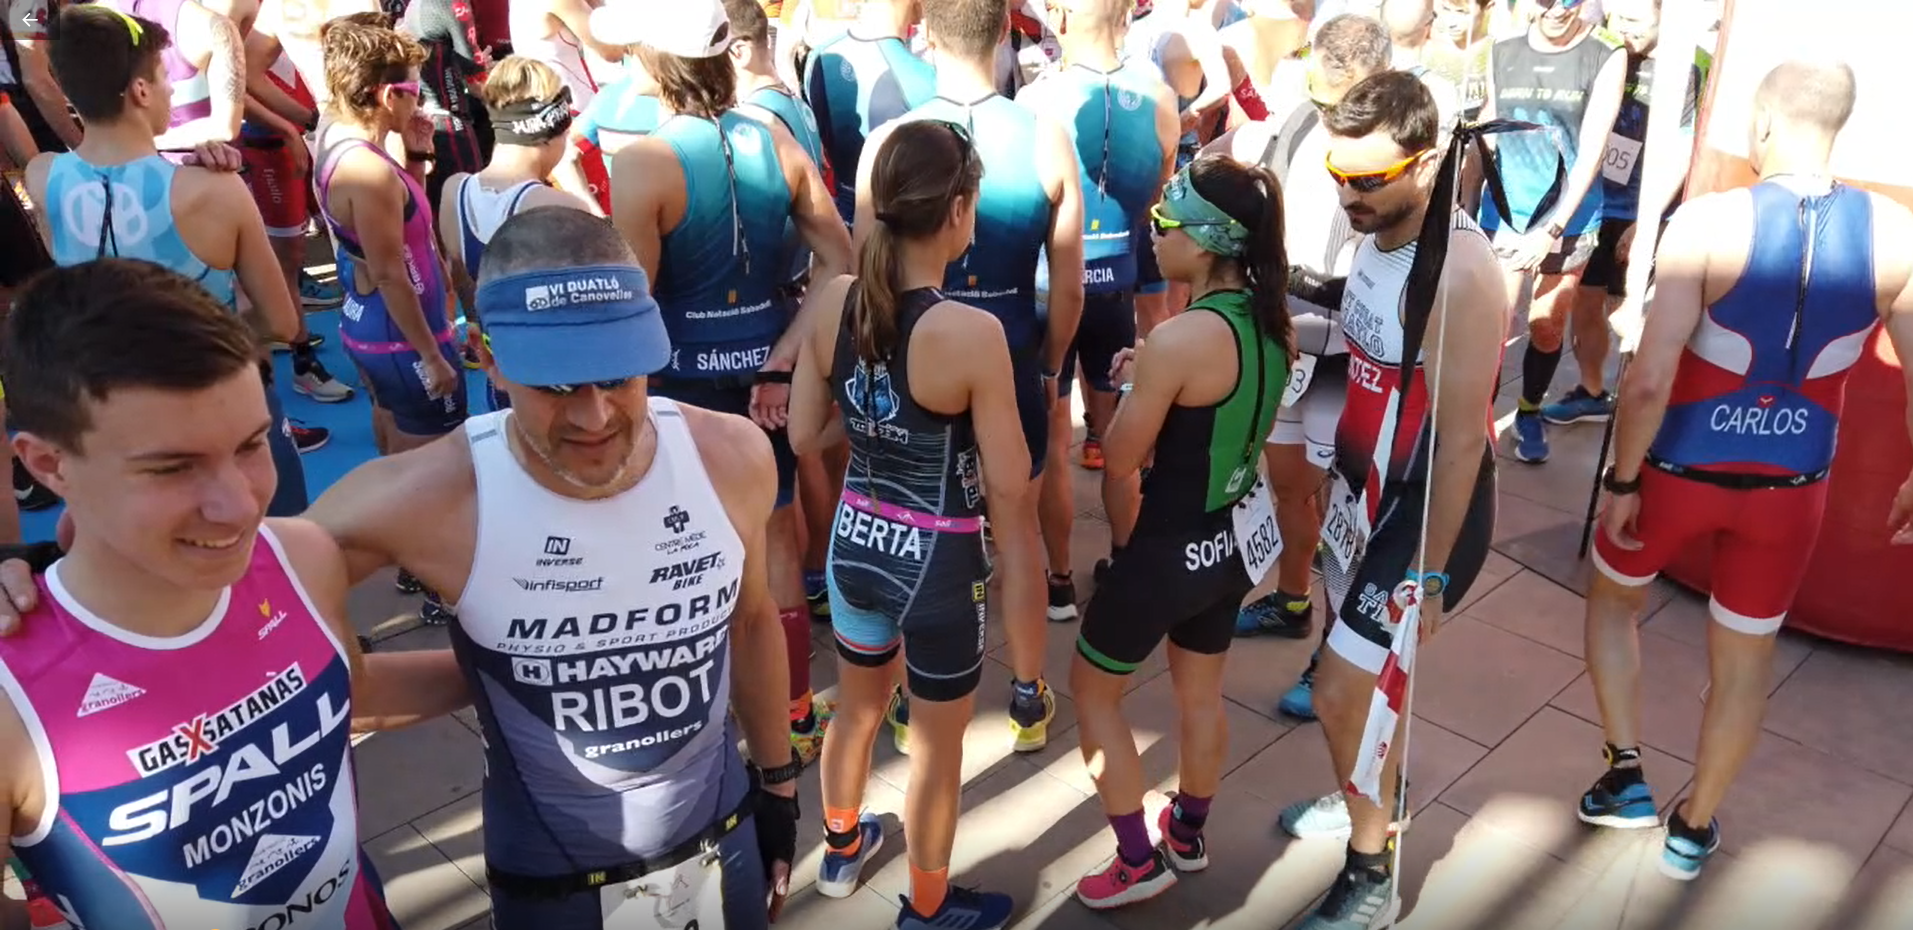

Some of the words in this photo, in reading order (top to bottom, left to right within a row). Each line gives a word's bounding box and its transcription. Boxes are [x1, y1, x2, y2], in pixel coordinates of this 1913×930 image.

[549, 283, 563, 296] VI
[567, 276, 620, 293] DUATLÓ
[1082, 268, 1114, 284] RCIA
[551, 297, 567, 307] de
[685, 311, 706, 319] Club
[1711, 404, 1808, 435] CARLOS
[546, 538, 569, 554] IN
[837, 503, 921, 560] BERTA
[1247, 515, 1279, 570] 4582
[536, 558, 583, 566] INVERSE
[649, 551, 721, 584] RAVET
[529, 577, 604, 592] infisport
[672, 574, 703, 591] BIKE
[507, 577, 738, 639] MADFORM
[258, 610, 287, 640] SPALL
[497, 642, 566, 653] PHYSIO
[596, 633, 658, 648] SPORT
[551, 659, 714, 732] RIBOT
[585, 720, 702, 758] granollers
[102, 692, 350, 846] SPALL
[183, 763, 327, 868] MONZONIS
[239, 837, 317, 891] granollers
[246, 859, 350, 930] ONOS
